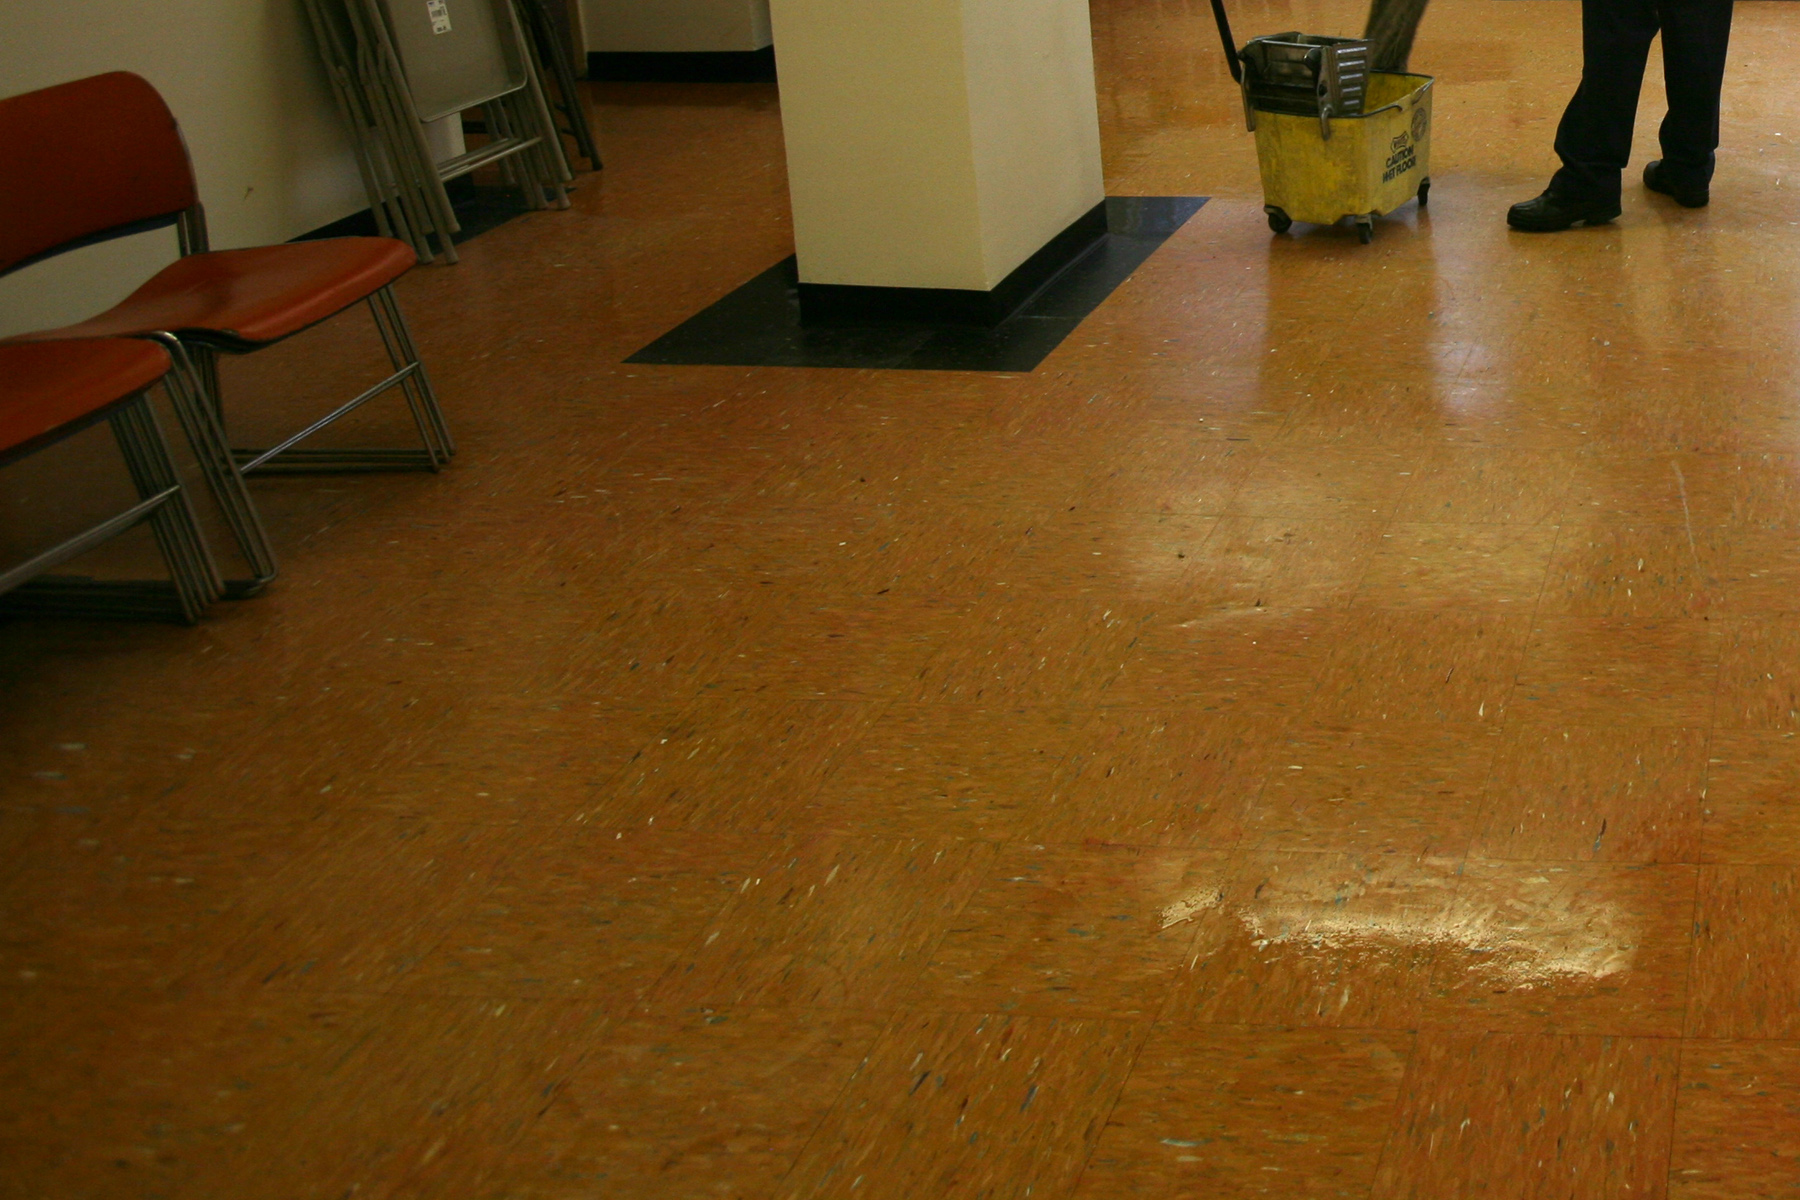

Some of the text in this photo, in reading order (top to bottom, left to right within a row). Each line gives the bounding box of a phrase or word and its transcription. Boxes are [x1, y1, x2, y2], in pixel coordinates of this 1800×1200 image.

[1382, 155, 1416, 184] WET FLOOR
[1385, 144, 1414, 169] CAUTION
